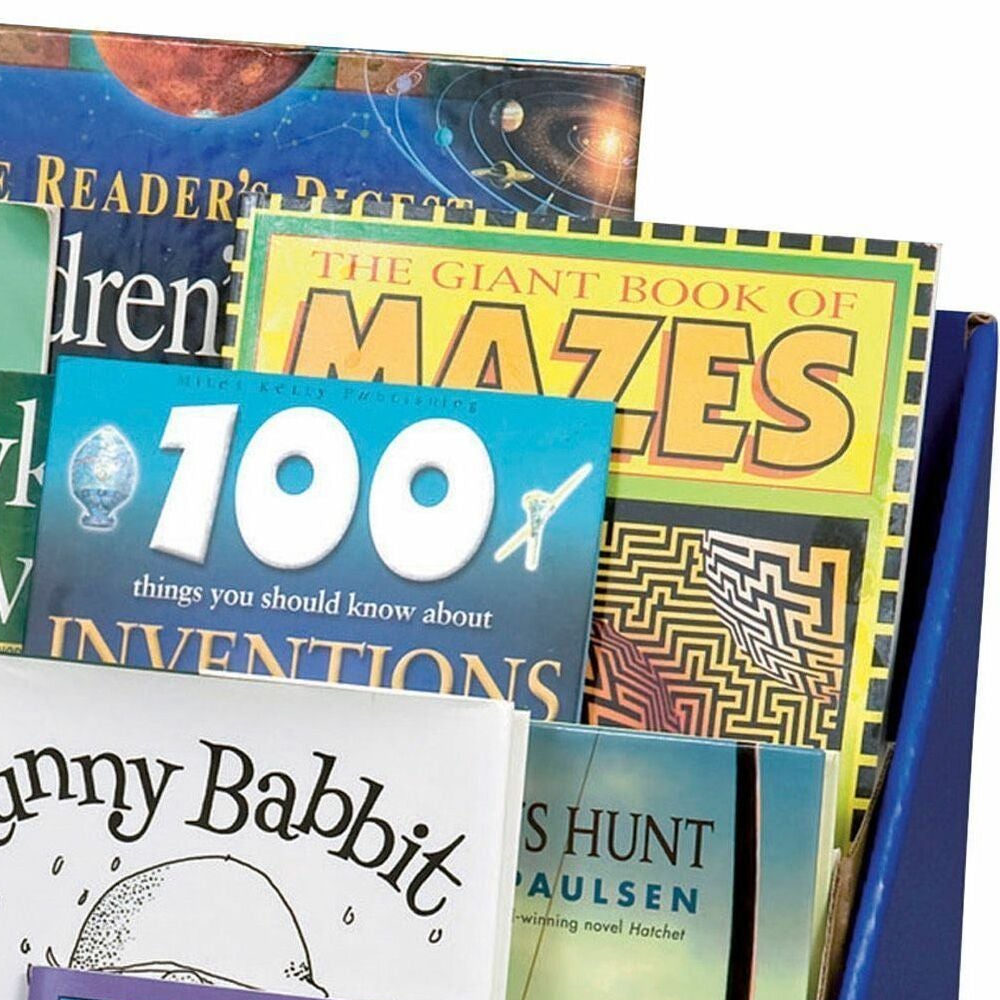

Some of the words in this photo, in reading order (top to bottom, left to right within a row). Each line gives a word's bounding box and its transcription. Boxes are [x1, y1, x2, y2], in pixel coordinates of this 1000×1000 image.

[312, 250, 412, 285] THE
[431, 260, 600, 301] GIANT
[621, 274, 767, 313] BOOK
[789, 287, 859, 320] OF
[287, 288, 859, 474] MAZES
[150, 403, 495, 582] 100
[133, 574, 203, 608] things
[211, 588, 254, 610] you
[261, 583, 340, 614] should
[348, 595, 416, 621] know
[423, 601, 493, 629] about
[185, 739, 466, 916] Babbit
[563, 805, 716, 869] HUNT
[584, 918, 623, 935] novel
[629, 921, 686, 941] Hatchet
